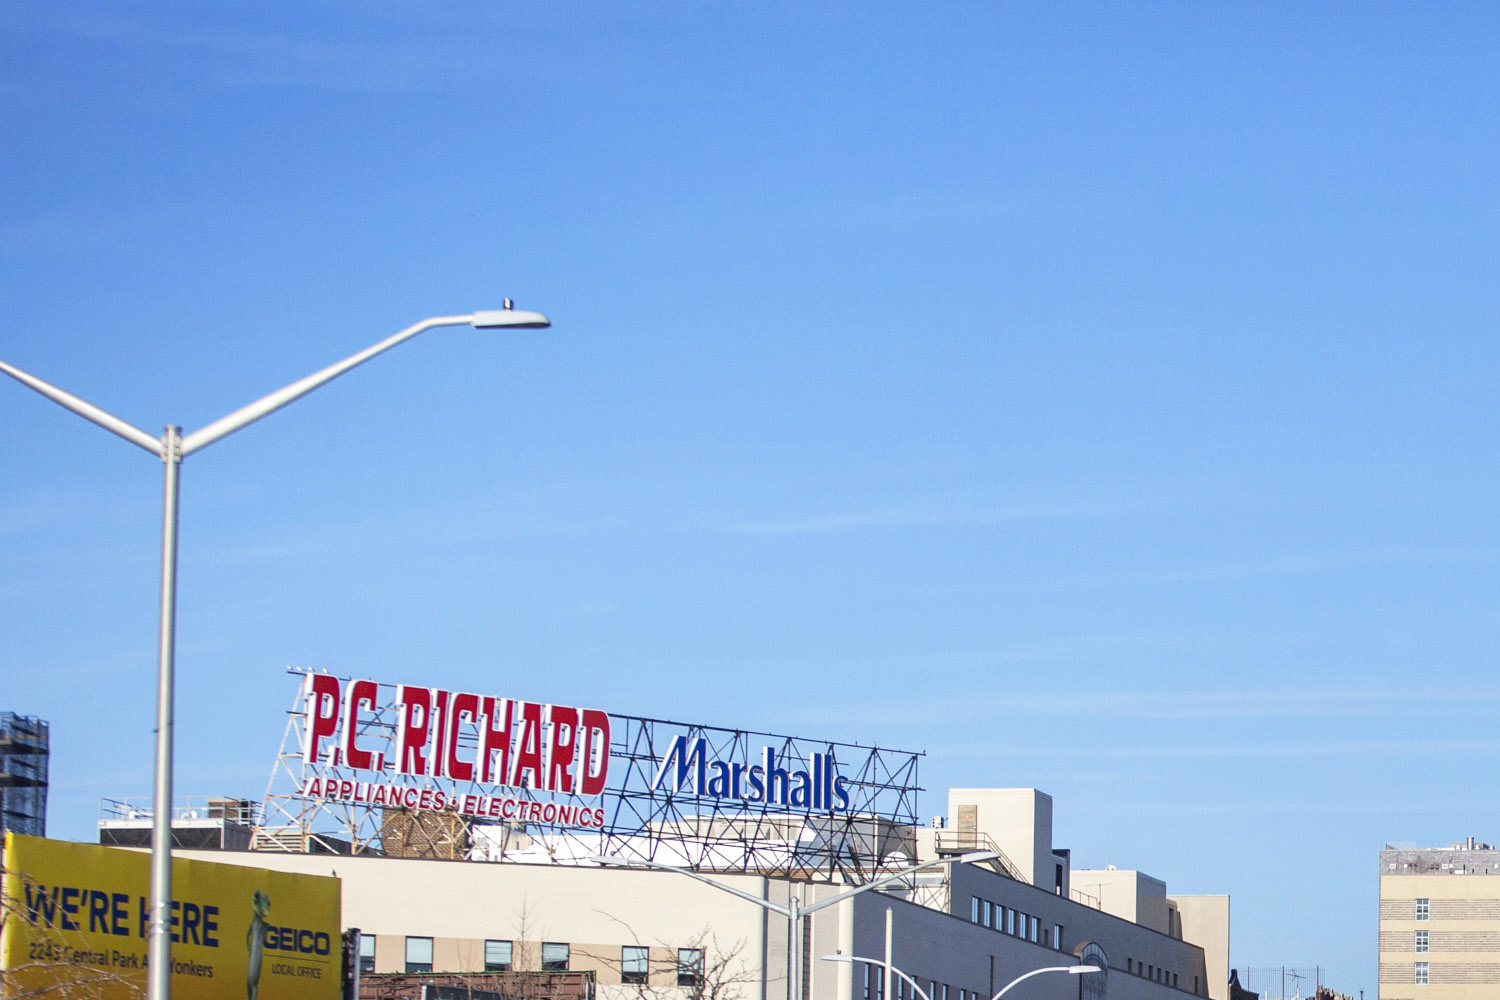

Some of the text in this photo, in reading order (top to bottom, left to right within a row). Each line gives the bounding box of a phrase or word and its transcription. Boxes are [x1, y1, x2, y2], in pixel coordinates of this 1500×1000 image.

[303, 672, 611, 796] P.C. RICHARD
[652, 735, 850, 812] Marshalls
[303, 777, 605, 829] APPLIANCES ELECTRONICS
[24, 883, 130, 936] WE'RE
[112, 952, 139, 969] Park
[170, 958, 213, 978] Yonkers
[264, 925, 330, 956] GEICO
[272, 964, 322, 979] LOCAL OFFICE
